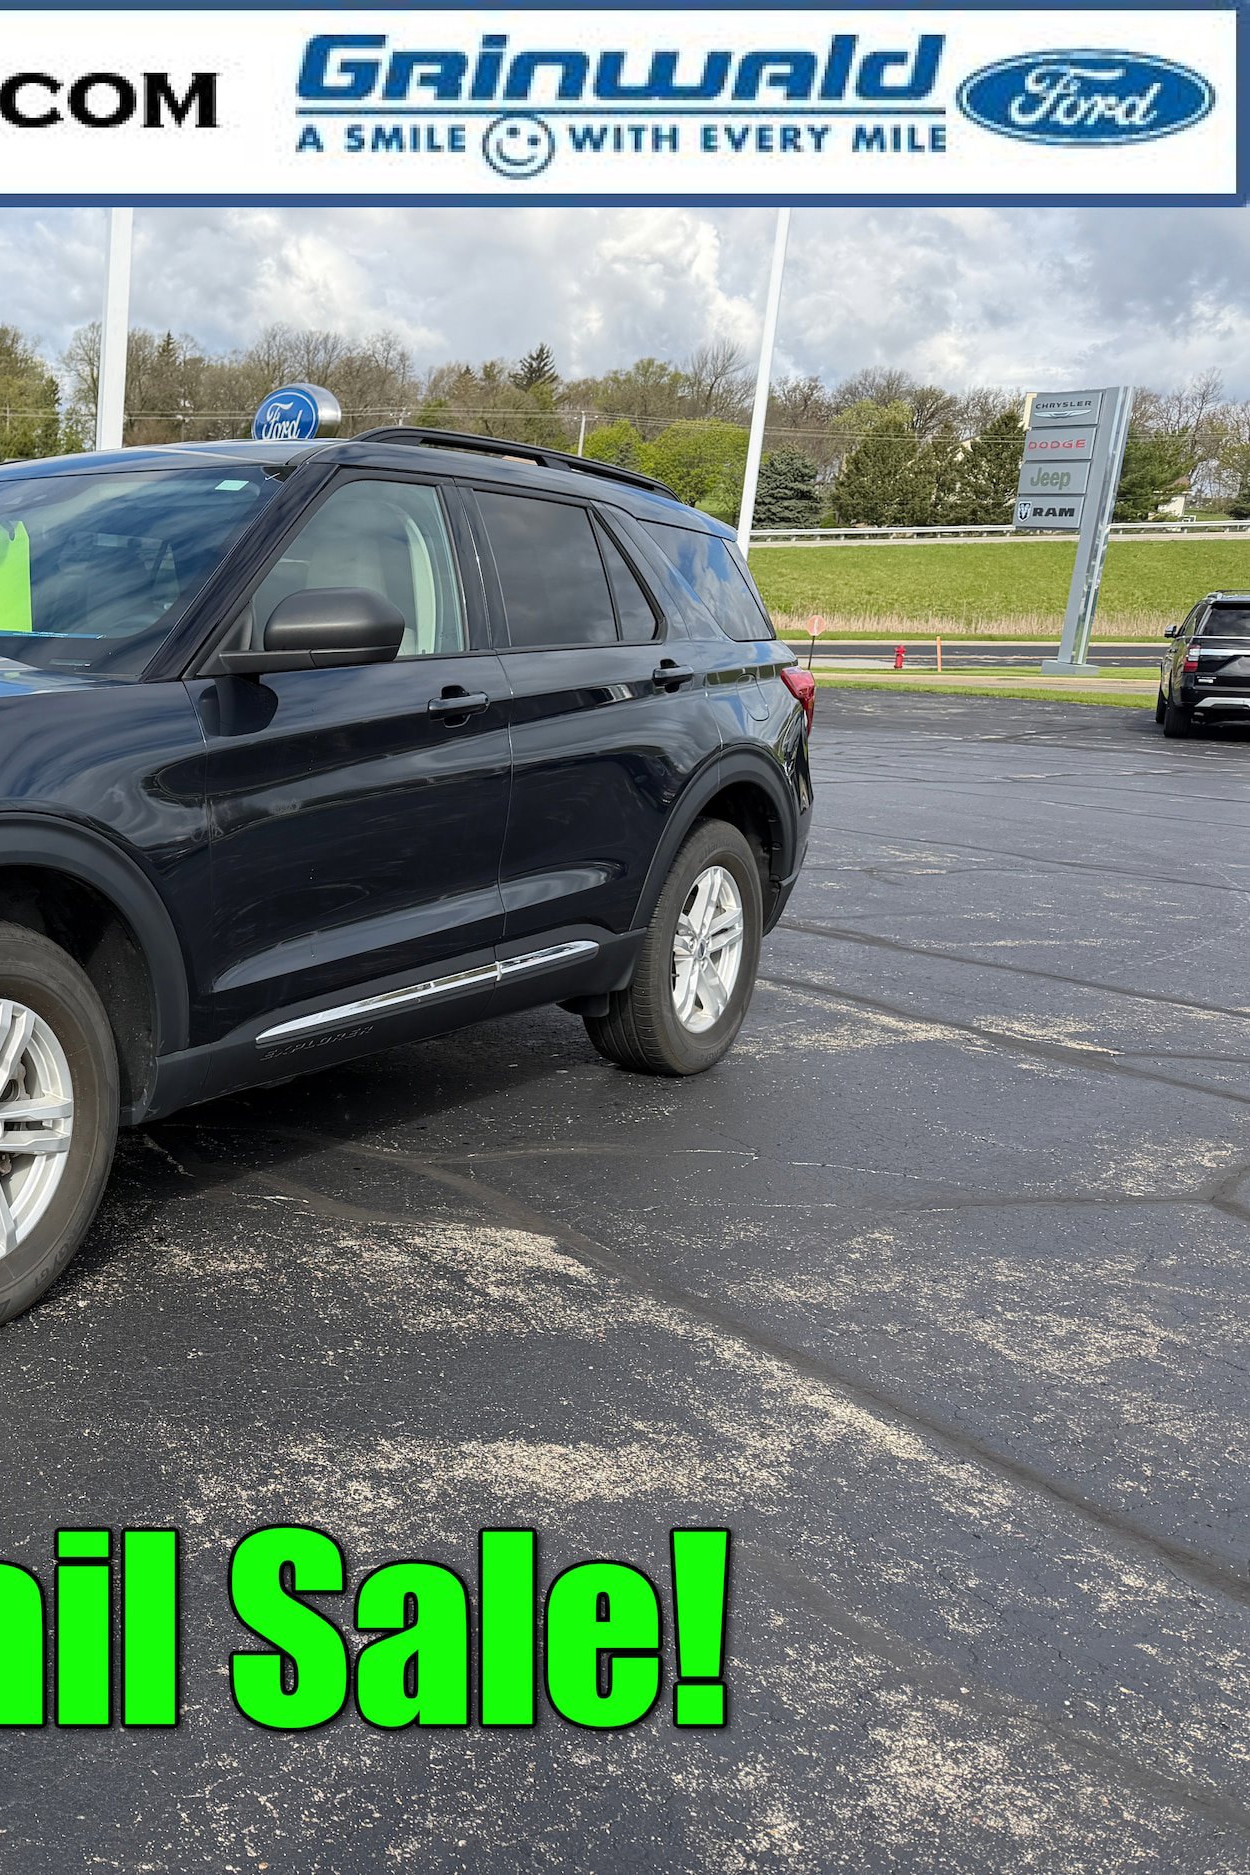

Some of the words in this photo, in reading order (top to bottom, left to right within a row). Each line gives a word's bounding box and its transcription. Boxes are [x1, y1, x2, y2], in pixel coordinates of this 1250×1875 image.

[1035, 401, 1092, 409] CHRYSLER
[261, 401, 304, 440] Ford
[1028, 439, 1087, 450] DODGE
[1030, 467, 1071, 490] Jeep
[1032, 507, 1075, 517] RAM
